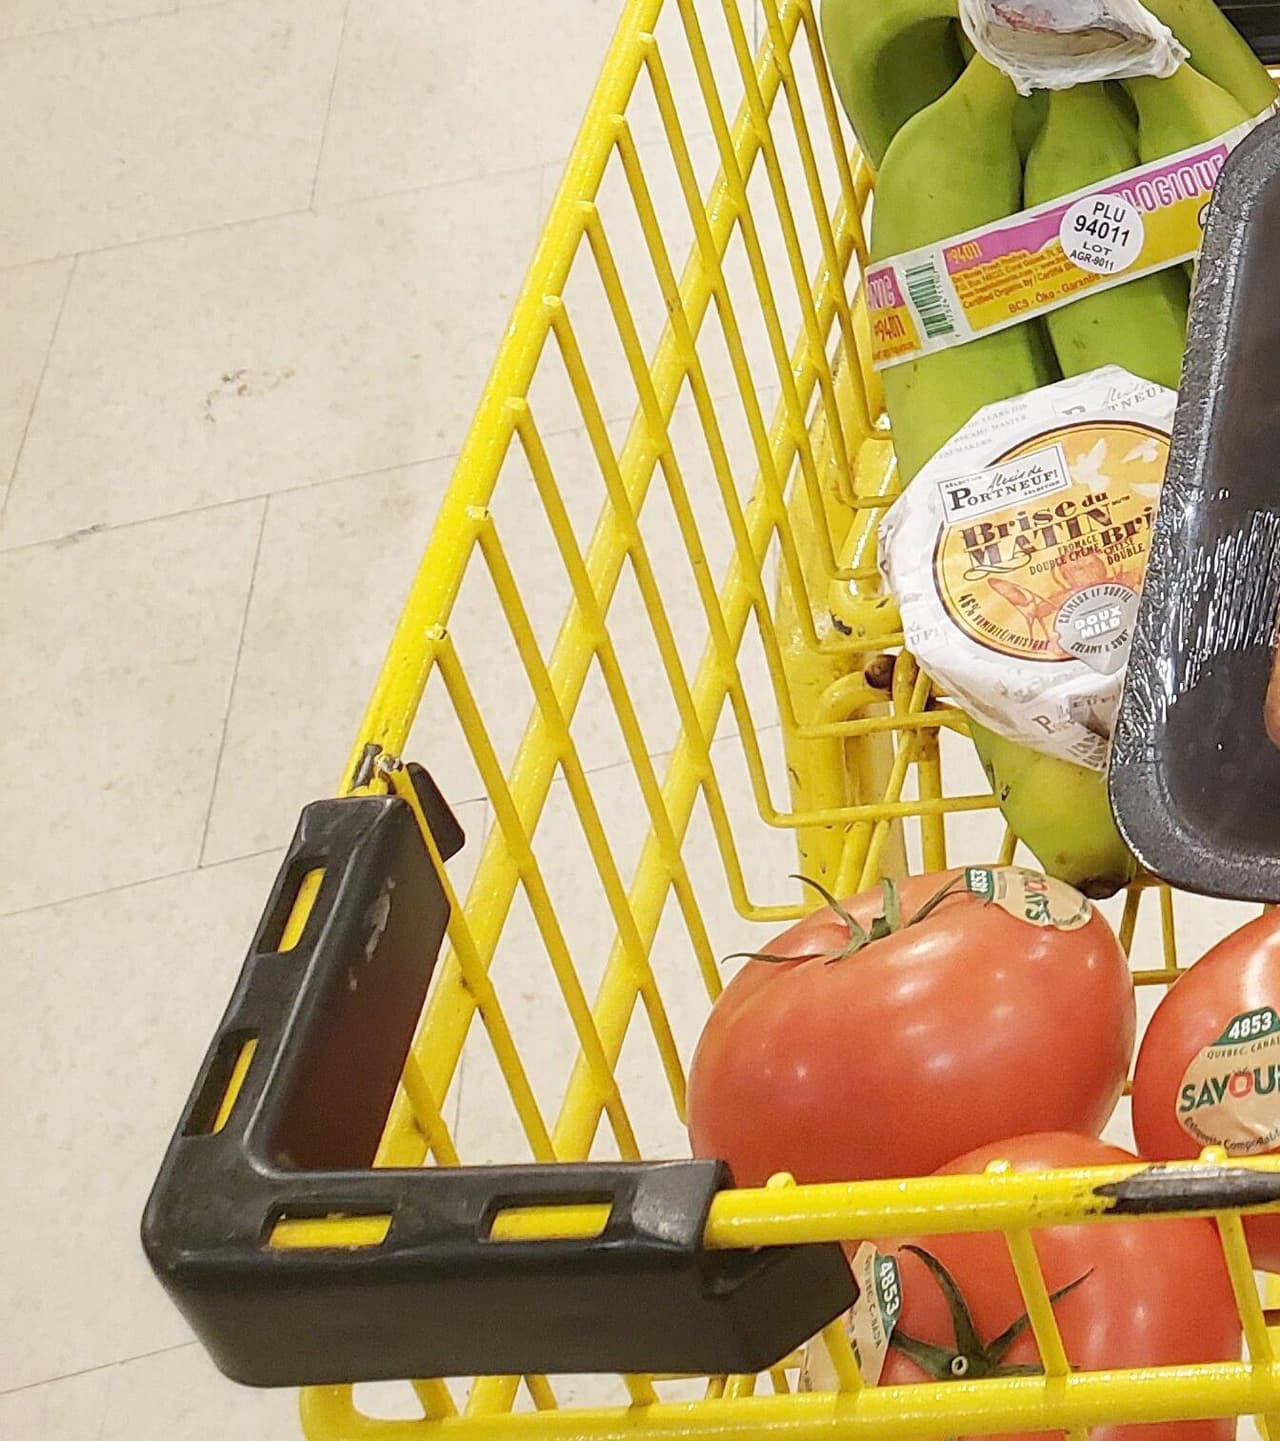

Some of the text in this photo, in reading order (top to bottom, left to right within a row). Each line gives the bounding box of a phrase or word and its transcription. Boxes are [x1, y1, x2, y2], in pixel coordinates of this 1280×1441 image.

[1092, 201, 1127, 223] PLU
[1073, 214, 1131, 248] 94011
[1082, 241, 1113, 257] LOT
[960, 491, 1108, 549] Brise du
[964, 502, 1113, 574] MATIN
[1028, 555, 1069, 576] DOUBLE
[1106, 543, 1146, 566] DOUBLE
[1073, 604, 1123, 631] DOUX
[1080, 616, 1122, 640] MILD
[1228, 1010, 1273, 1041] 4853
[879, 1260, 901, 1316] 4853
